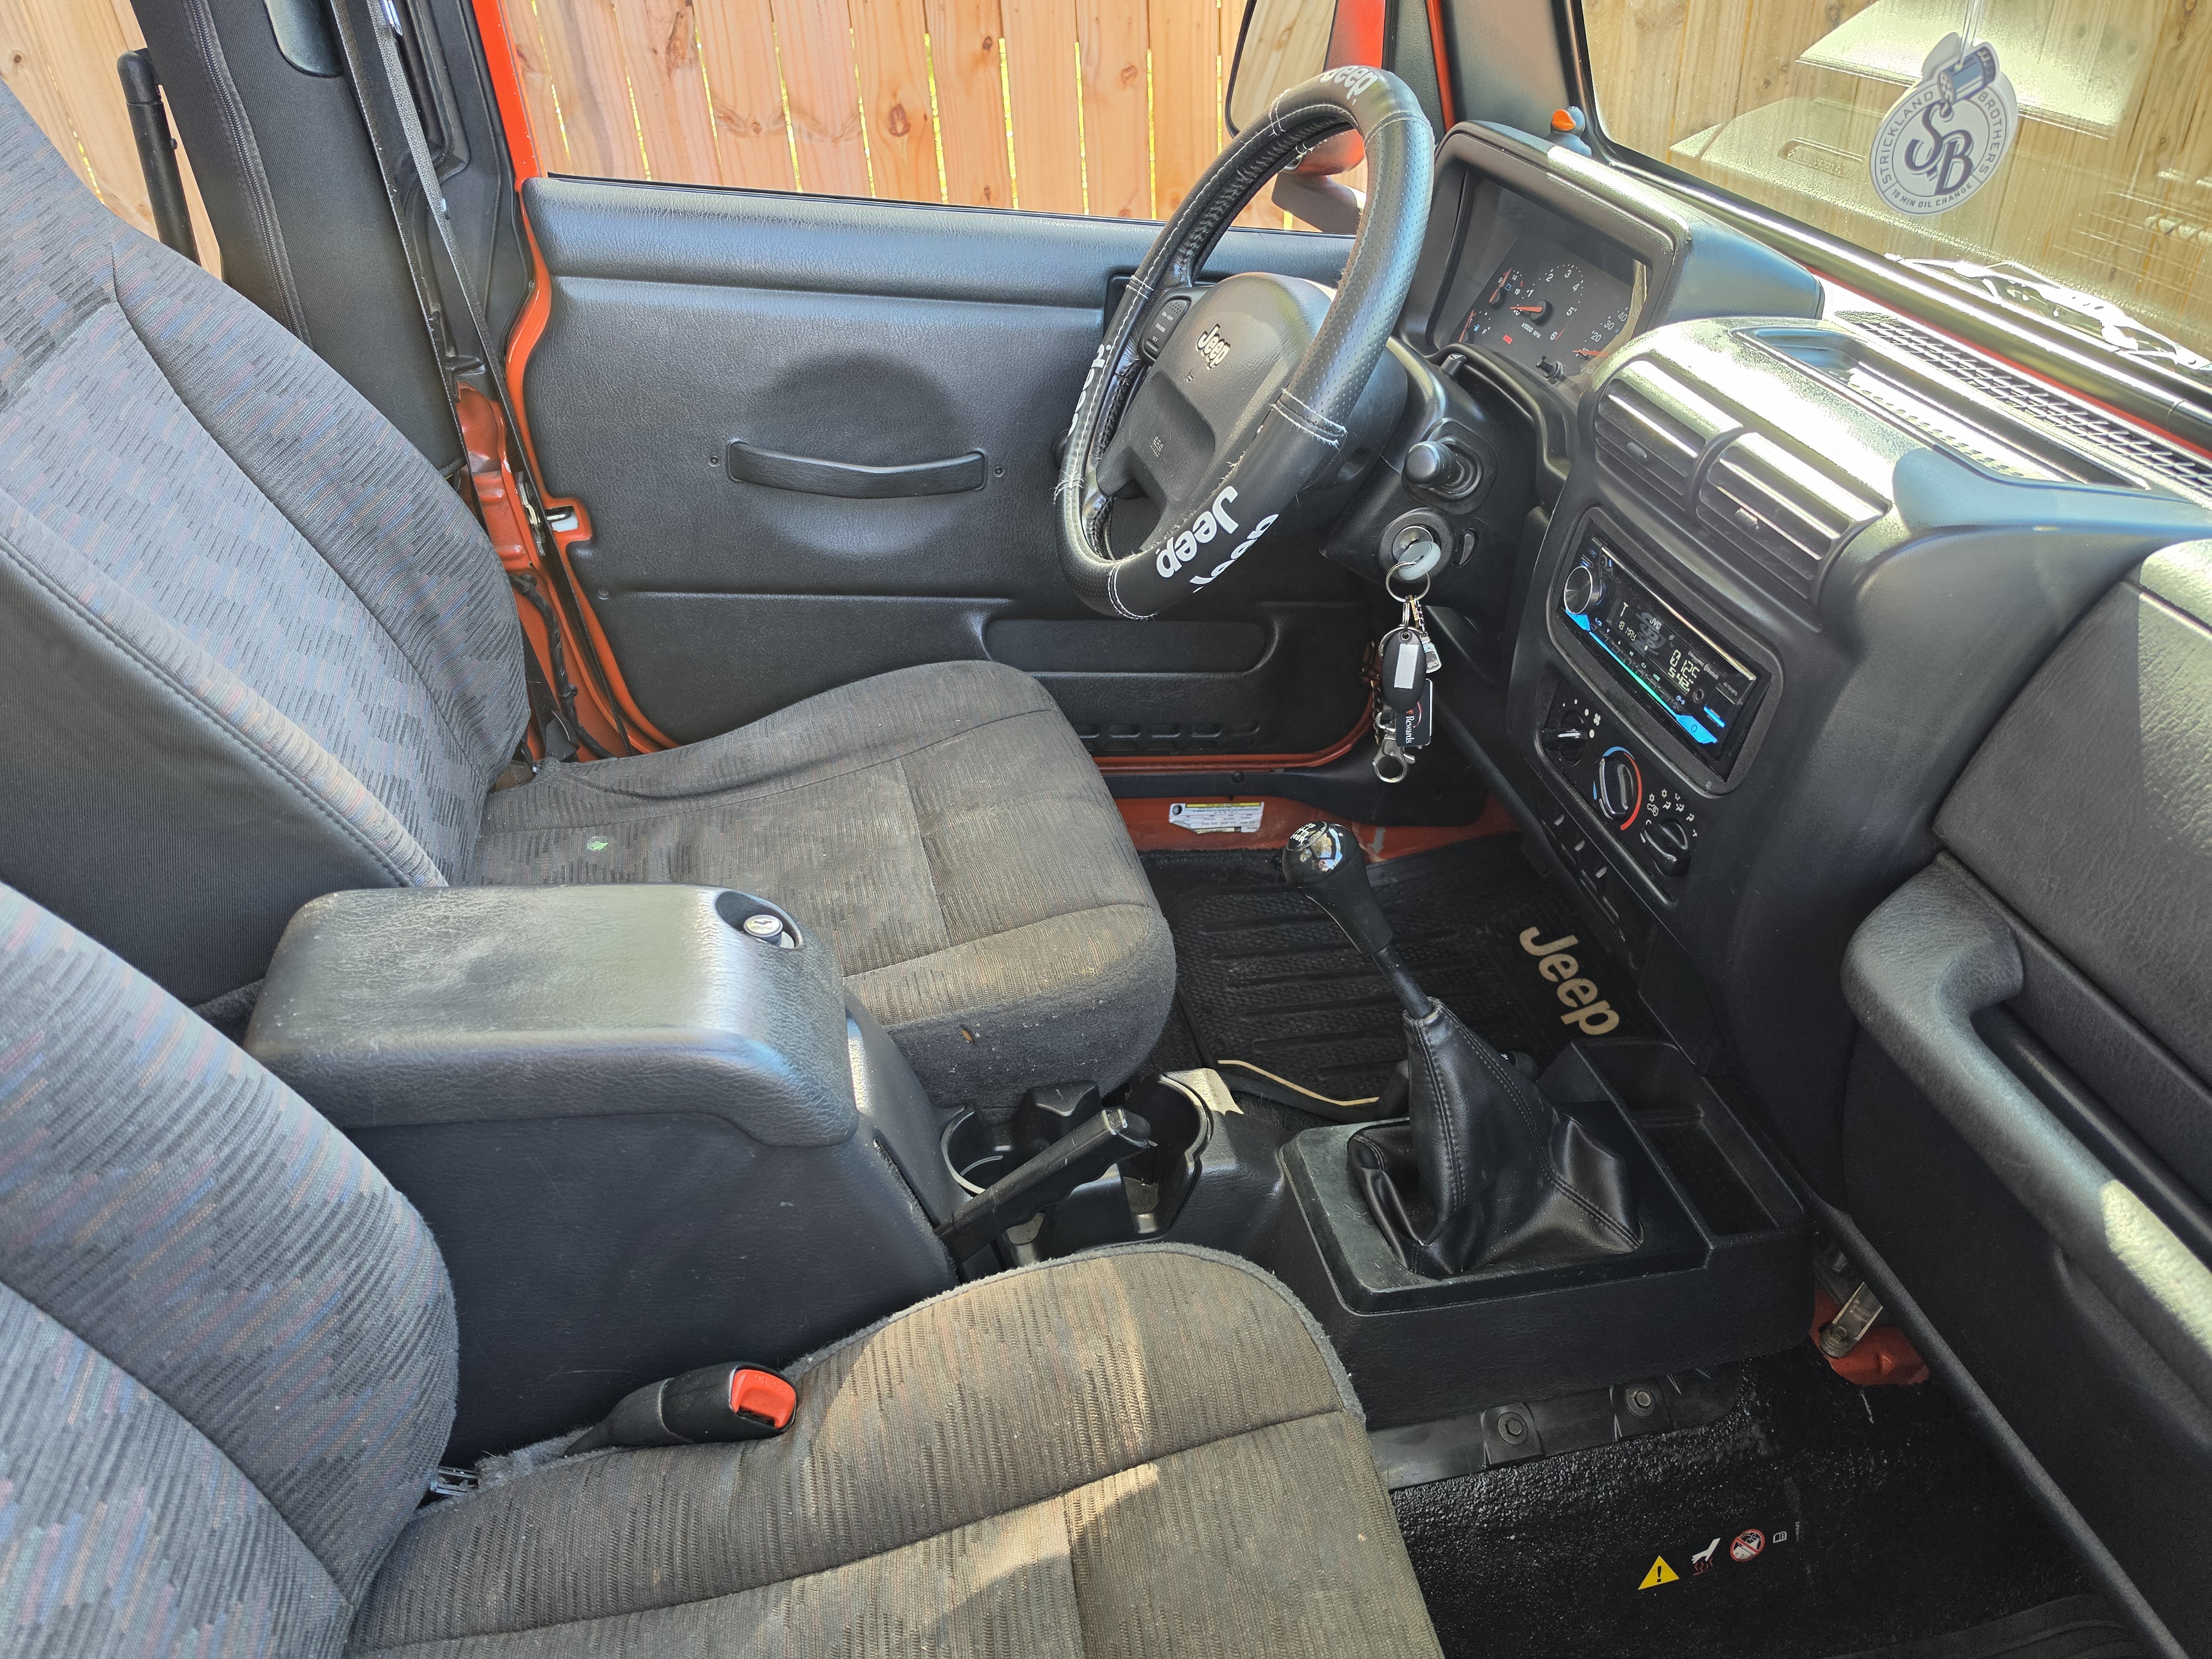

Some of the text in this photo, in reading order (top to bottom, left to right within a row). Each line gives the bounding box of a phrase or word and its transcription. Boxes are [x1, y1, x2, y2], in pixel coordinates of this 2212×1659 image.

[1880, 90, 1933, 185] STRICKLAND
[1978, 91, 2002, 174] BROTHERS
[1892, 189, 1900, 199] 10
[1900, 195, 1915, 207] MIN
[1936, 182, 1973, 207] CHANGE
[1546, 273, 1554, 283] 2
[1564, 269, 1572, 278] 3
[1572, 283, 1580, 292] 4
[1528, 289, 1534, 298] 1
[1566, 306, 1574, 316] 5
[1618, 312, 1628, 322] 40
[1604, 320, 1615, 331] 30
[1532, 330, 1541, 339] RPM
[1550, 331, 1558, 341] 6
[1590, 331, 1602, 342] 20
[1196, 324, 1231, 369] Jeep
[1156, 486, 1239, 578] Jeep
[1649, 617, 1662, 630] JVC
[1405, 716, 1415, 744] Rewards
[1519, 926, 1620, 1035] Jeep
[754, 1374, 787, 1394] PRESS
